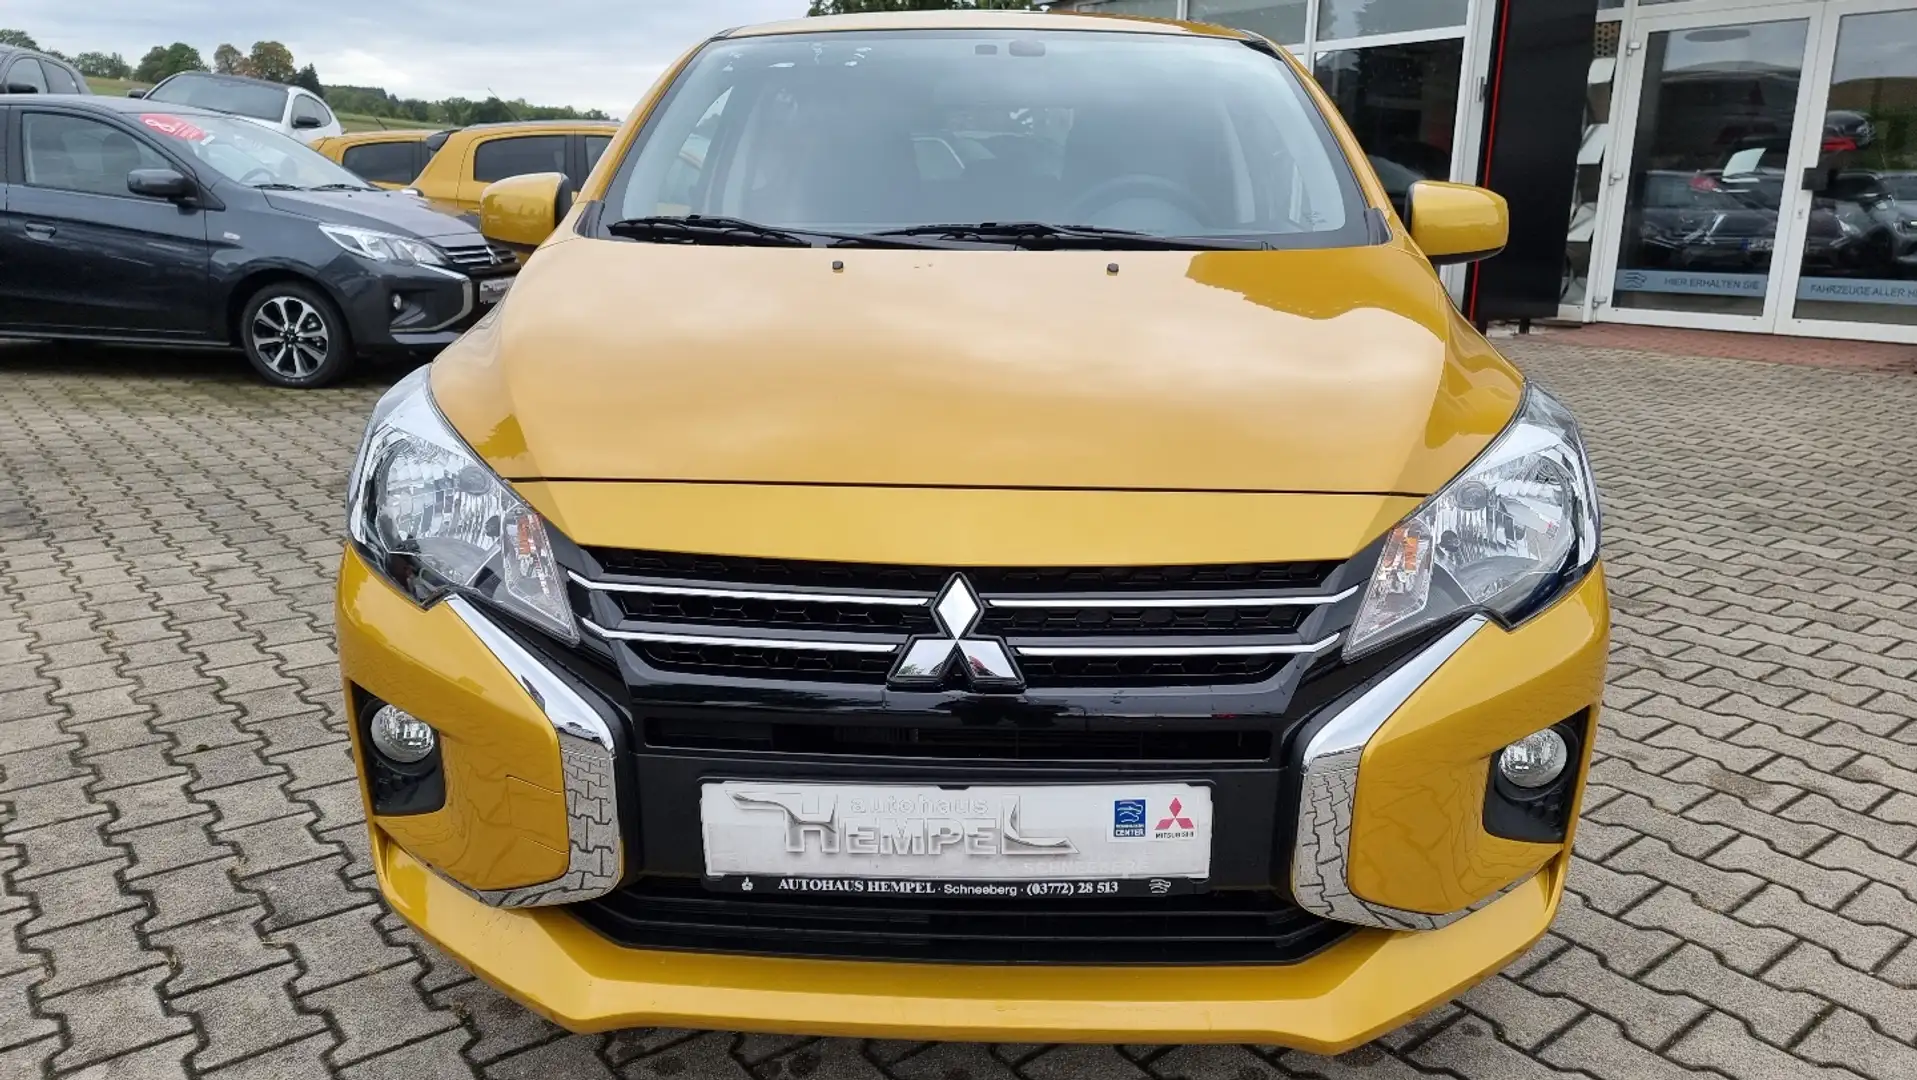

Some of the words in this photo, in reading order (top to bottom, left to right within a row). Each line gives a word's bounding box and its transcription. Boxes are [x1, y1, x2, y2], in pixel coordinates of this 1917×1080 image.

[1664, 277, 1688, 286] HIER
[1689, 278, 1741, 289] ERHALTEN
[1742, 281, 1760, 290] SIE
[1810, 284, 1873, 296] FAHRZEUGE
[1872, 285, 1906, 298] ALLER
[850, 793, 989, 814] autohaus
[725, 789, 1081, 856] HEMPEL
[1115, 828, 1145, 837] CENTER
[778, 878, 864, 893] AUTOHAUS
[867, 879, 936, 894] HEMPEL
[943, 883, 1018, 898] Schneeberg
[1026, 882, 1074, 897] (03772)
[1077, 882, 1094, 895] 28
[1096, 881, 1119, 894] 513
